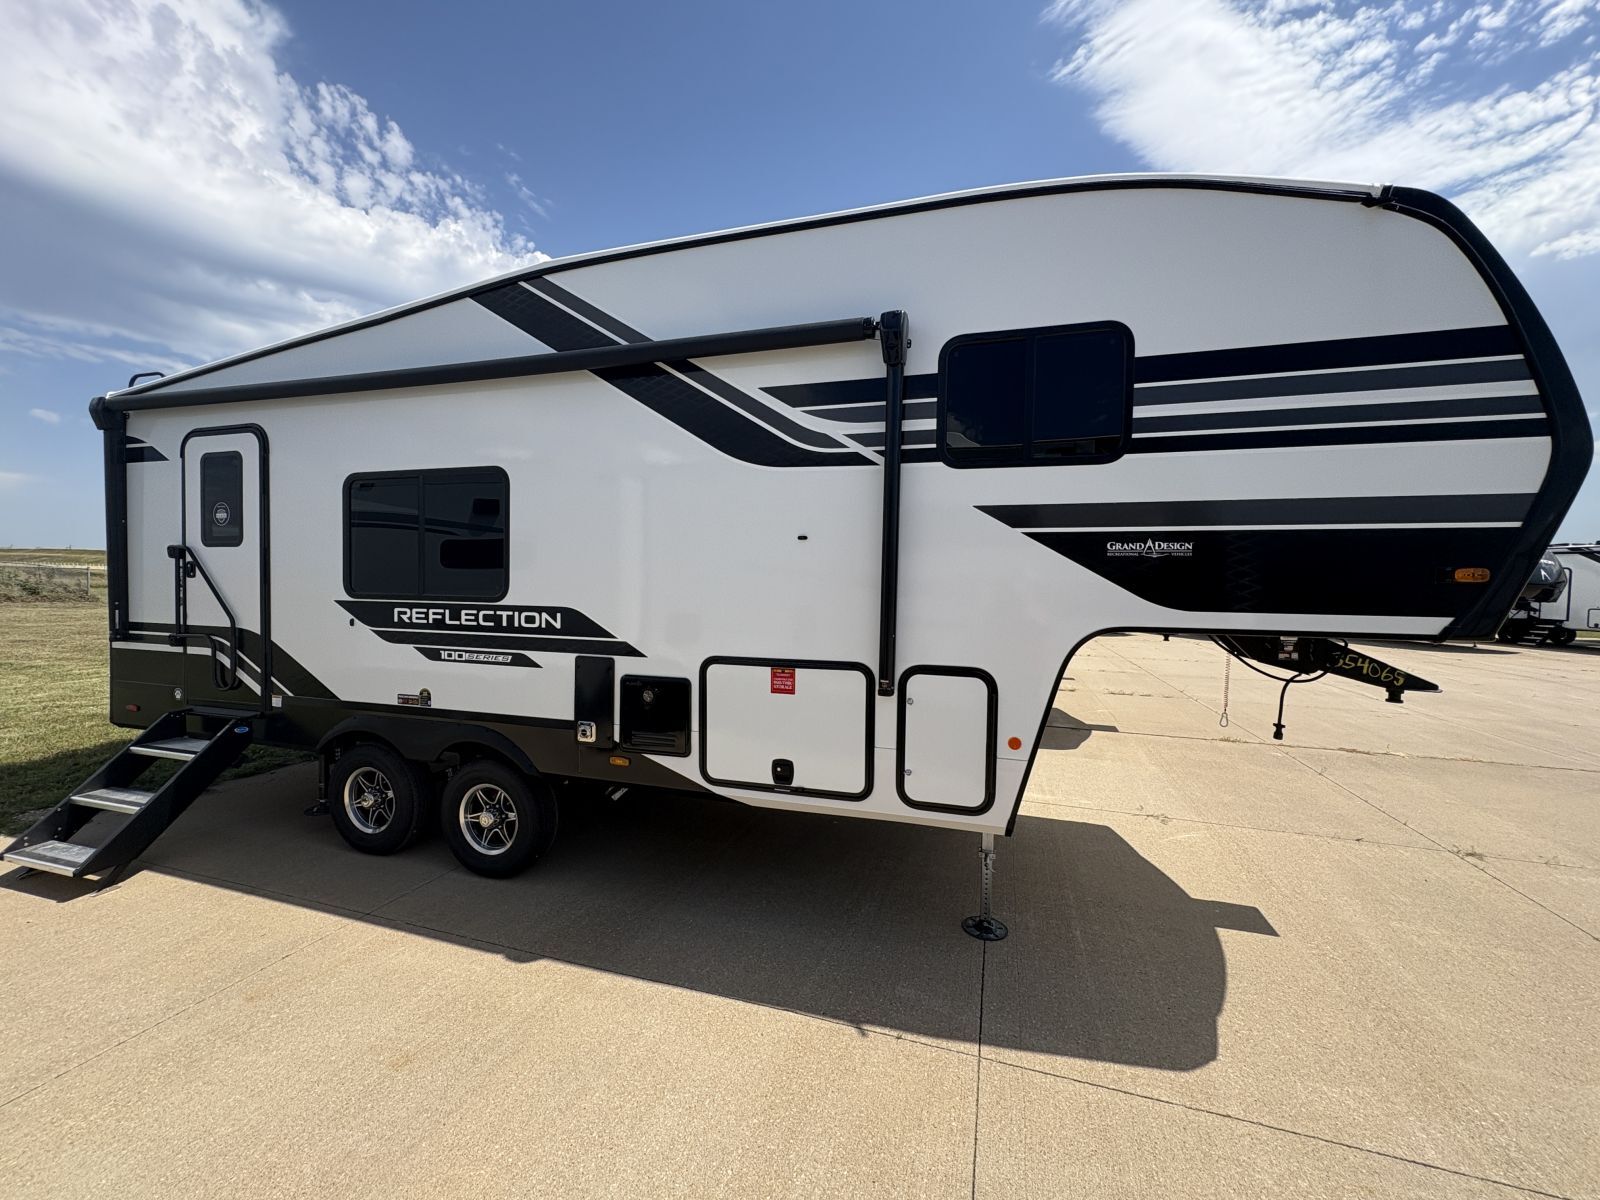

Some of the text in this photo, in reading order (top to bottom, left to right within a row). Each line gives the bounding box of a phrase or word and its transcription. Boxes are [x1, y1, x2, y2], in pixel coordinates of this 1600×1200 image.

[1106, 541, 1193, 550] GRAND DESIGN
[393, 607, 562, 629] REFLECTION
